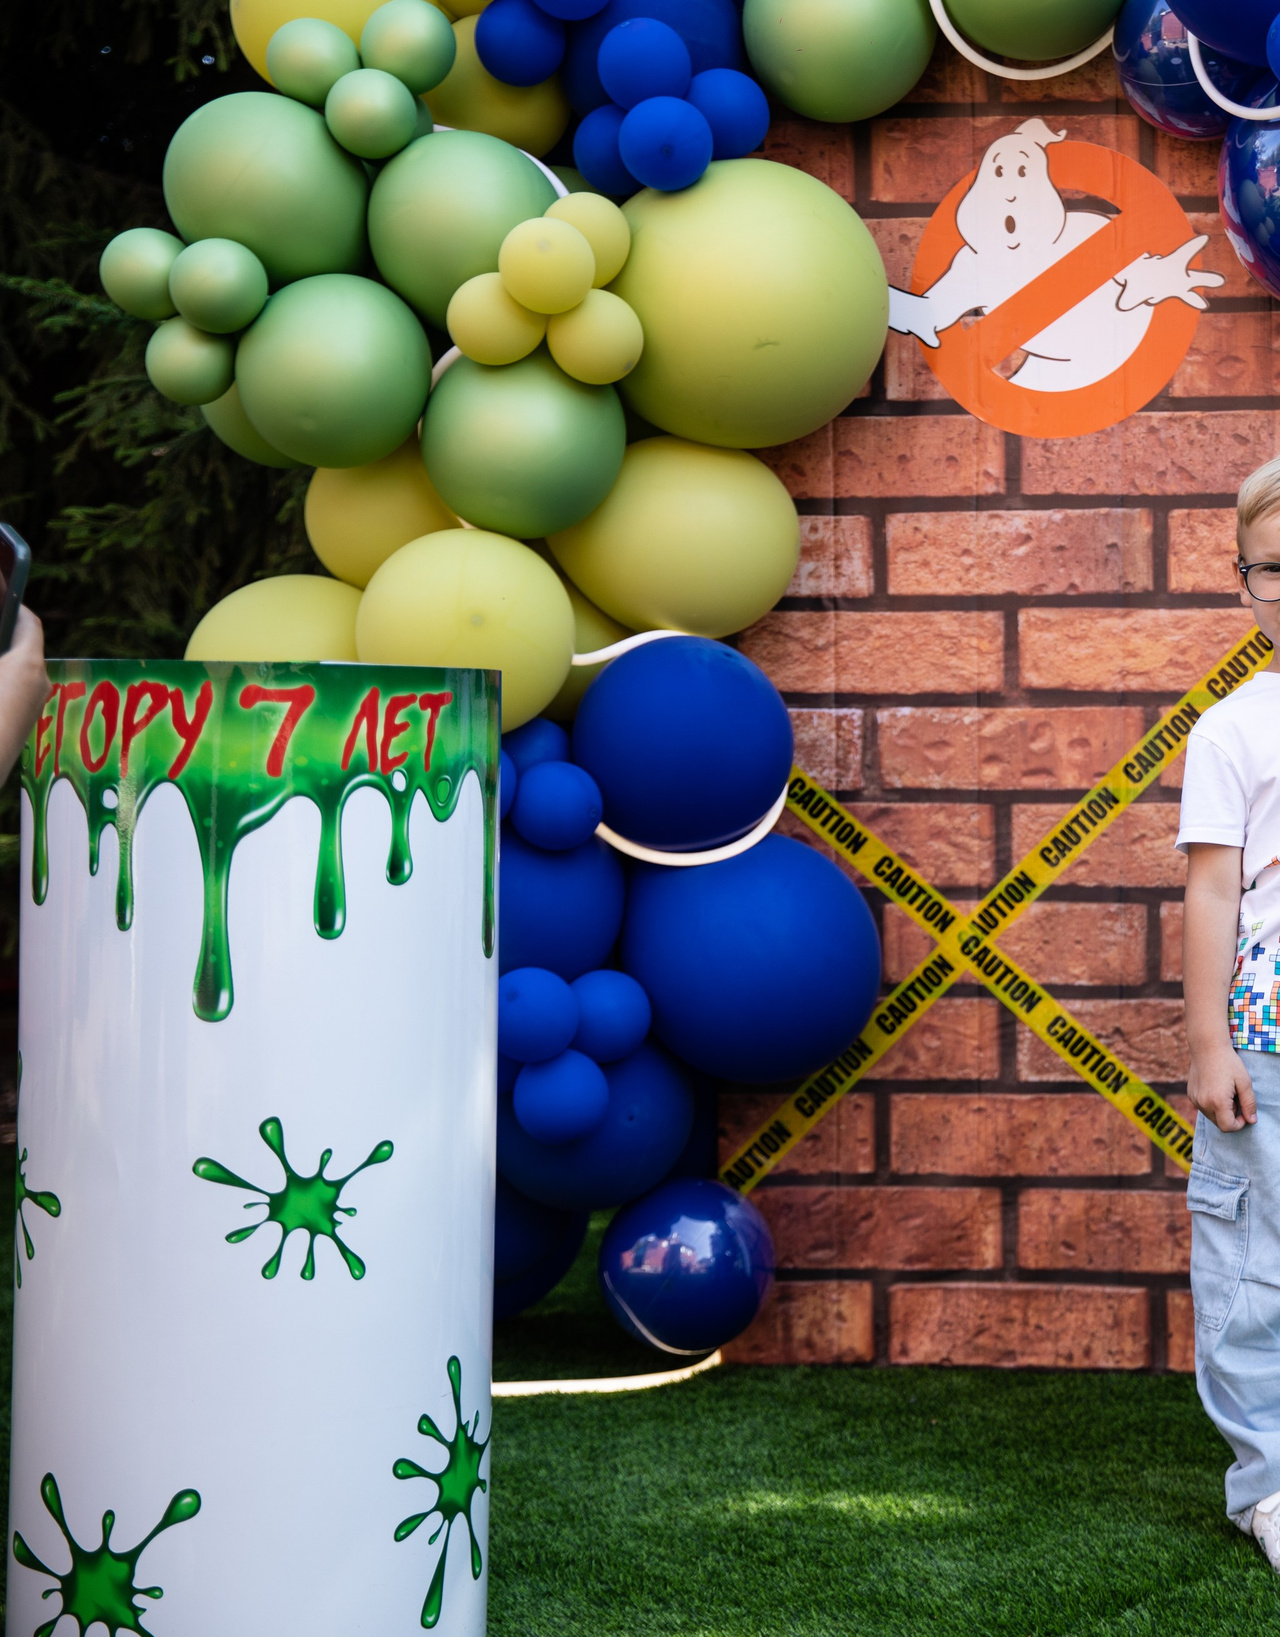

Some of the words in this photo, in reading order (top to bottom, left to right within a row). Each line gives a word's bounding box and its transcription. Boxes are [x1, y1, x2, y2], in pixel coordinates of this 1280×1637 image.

[239, 684, 315, 777] 7
[341, 687, 453, 775] ЛЕТ
[723, 1119, 792, 1190] AUTION
[794, 1038, 874, 1118] CAUTION
[875, 954, 955, 1035] CAUTION
[1039, 786, 1120, 868] CAUTION
[1122, 702, 1201, 784] CAUTION
[1206, 630, 1274, 700] CAUTIO
[787, 777, 868, 856] CAUTION
[872, 856, 955, 934] CAUTION
[960, 935, 1043, 1014] CAUTION
[1046, 1015, 1129, 1094] CAUTION
[1133, 1097, 1193, 1163] CAUTI
